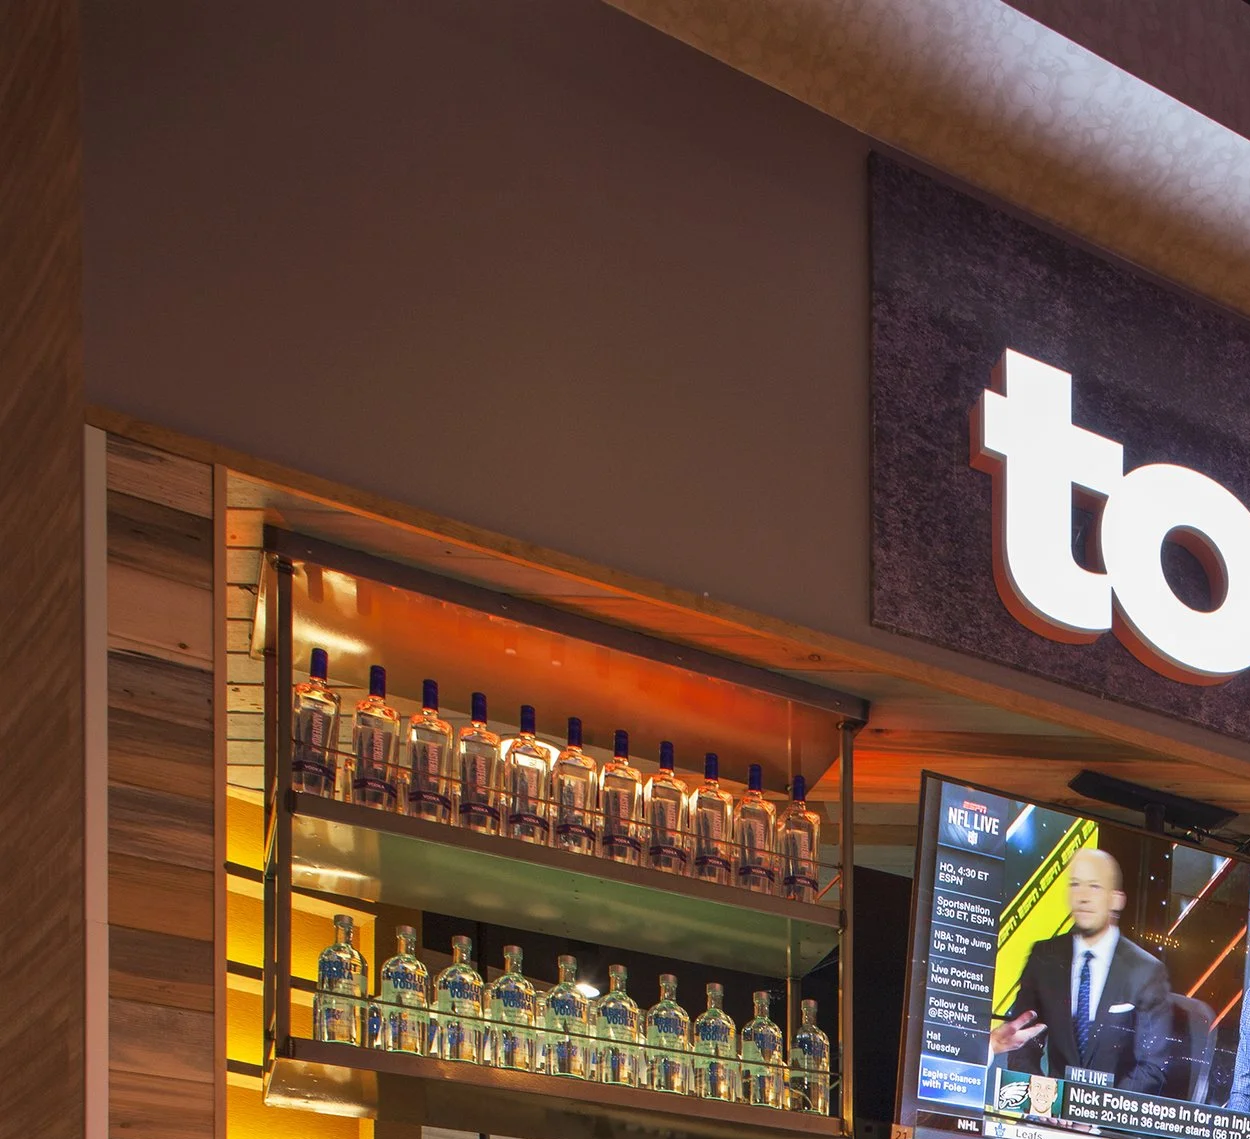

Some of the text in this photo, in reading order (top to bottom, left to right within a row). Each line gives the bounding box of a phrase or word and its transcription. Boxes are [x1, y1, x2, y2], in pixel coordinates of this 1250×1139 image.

[962, 800, 987, 813] ESPN
[948, 807, 1000, 835] NFL LIVE
[939, 873, 963, 886] ESPN
[958, 866, 976, 879] 4:30
[977, 871, 989, 881] ET
[937, 895, 990, 916] SportsNation
[936, 907, 995, 927] 3:30 ET, ESPN
[933, 940, 967, 955] Up Next
[934, 929, 992, 951] NBA: The Jump
[931, 962, 984, 982] Live Podcast
[930, 974, 949, 986] Now
[951, 978, 962, 987] on
[929, 996, 969, 1012] Follow Us
[928, 1007, 977, 1024] @ESPNNFL
[926, 1030, 941, 1041] Hat
[926, 1040, 960, 1056] Tuesday
[922, 1067, 982, 1086] Eagles Chances
[1071, 1068, 1108, 1087] NFL LIVE
[921, 1079, 967, 1094] with Foles
[1069, 1087, 1100, 1106] Nick
[1103, 1093, 1138, 1113] Foles
[1141, 1100, 1176, 1120] steps
[1179, 1106, 1190, 1121] in
[1194, 1108, 1211, 1125] for
[1213, 1114, 1230, 1129] an
[957, 1118, 980, 1132] NHL
[1068, 1105, 1098, 1120] Foles:
[1101, 1111, 1128, 1125] 20-16
[1129, 1115, 1139, 1126] in
[1140, 1117, 1153, 1128] 36
[1154, 1121, 1184, 1134] career
[1185, 1125, 1211, 1139] starts
